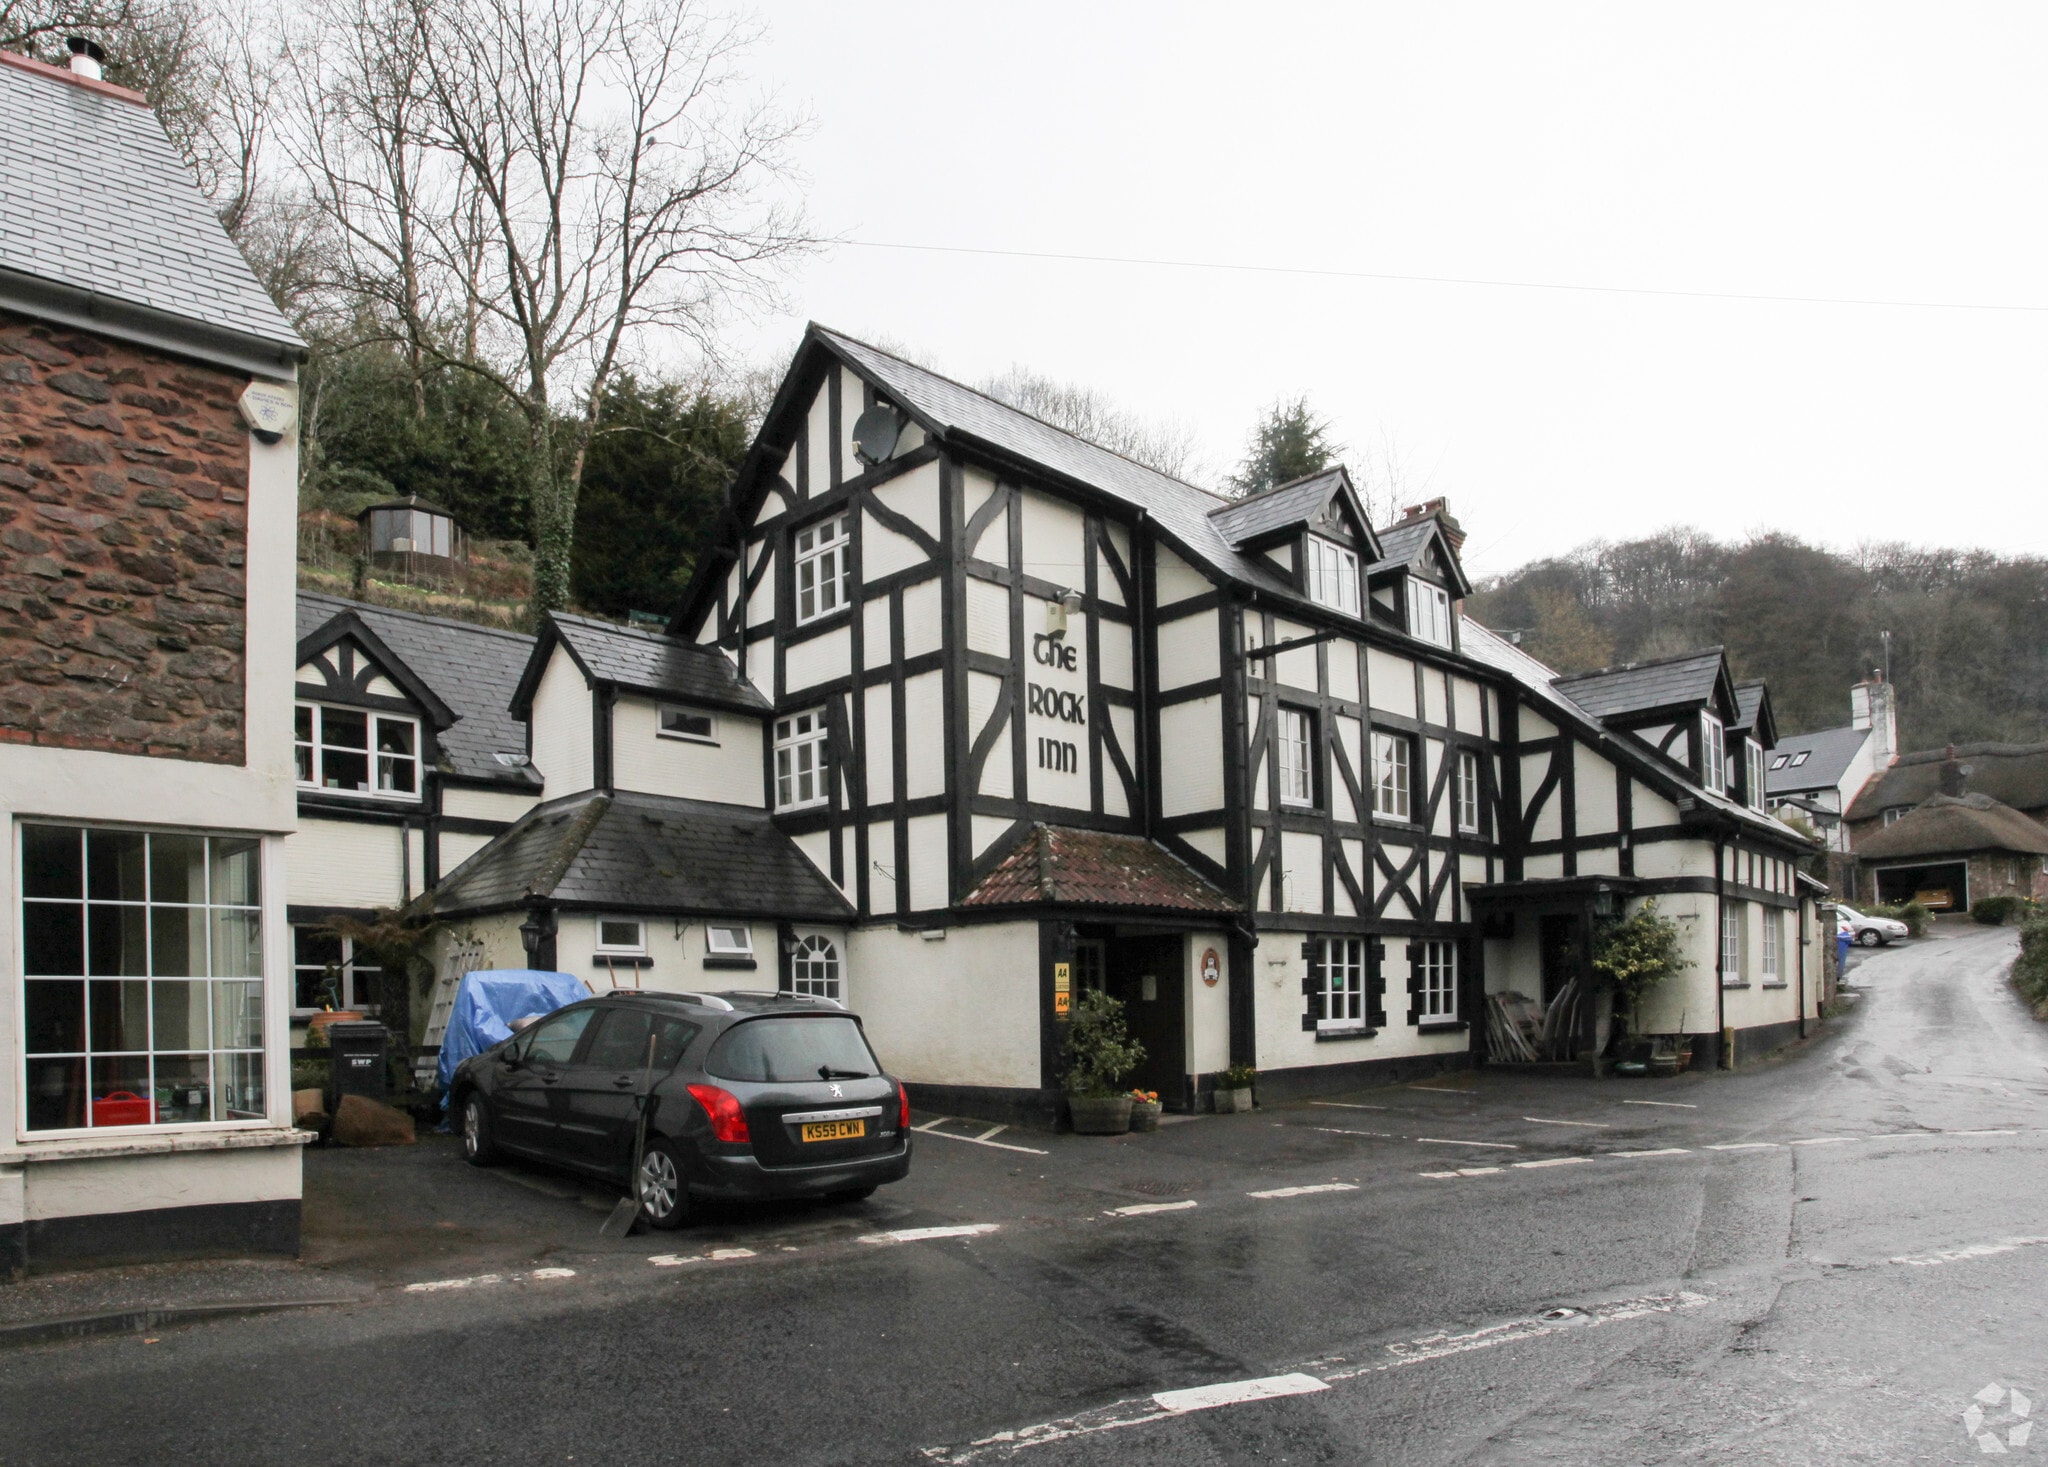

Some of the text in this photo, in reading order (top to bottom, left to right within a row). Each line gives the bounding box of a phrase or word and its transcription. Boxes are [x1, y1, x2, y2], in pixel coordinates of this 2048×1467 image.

[1028, 682, 1085, 725] ROCK
[1057, 968, 1067, 978] AA
[1057, 997, 1068, 1007] AA
[807, 1121, 860, 1138] KS59 CWN
